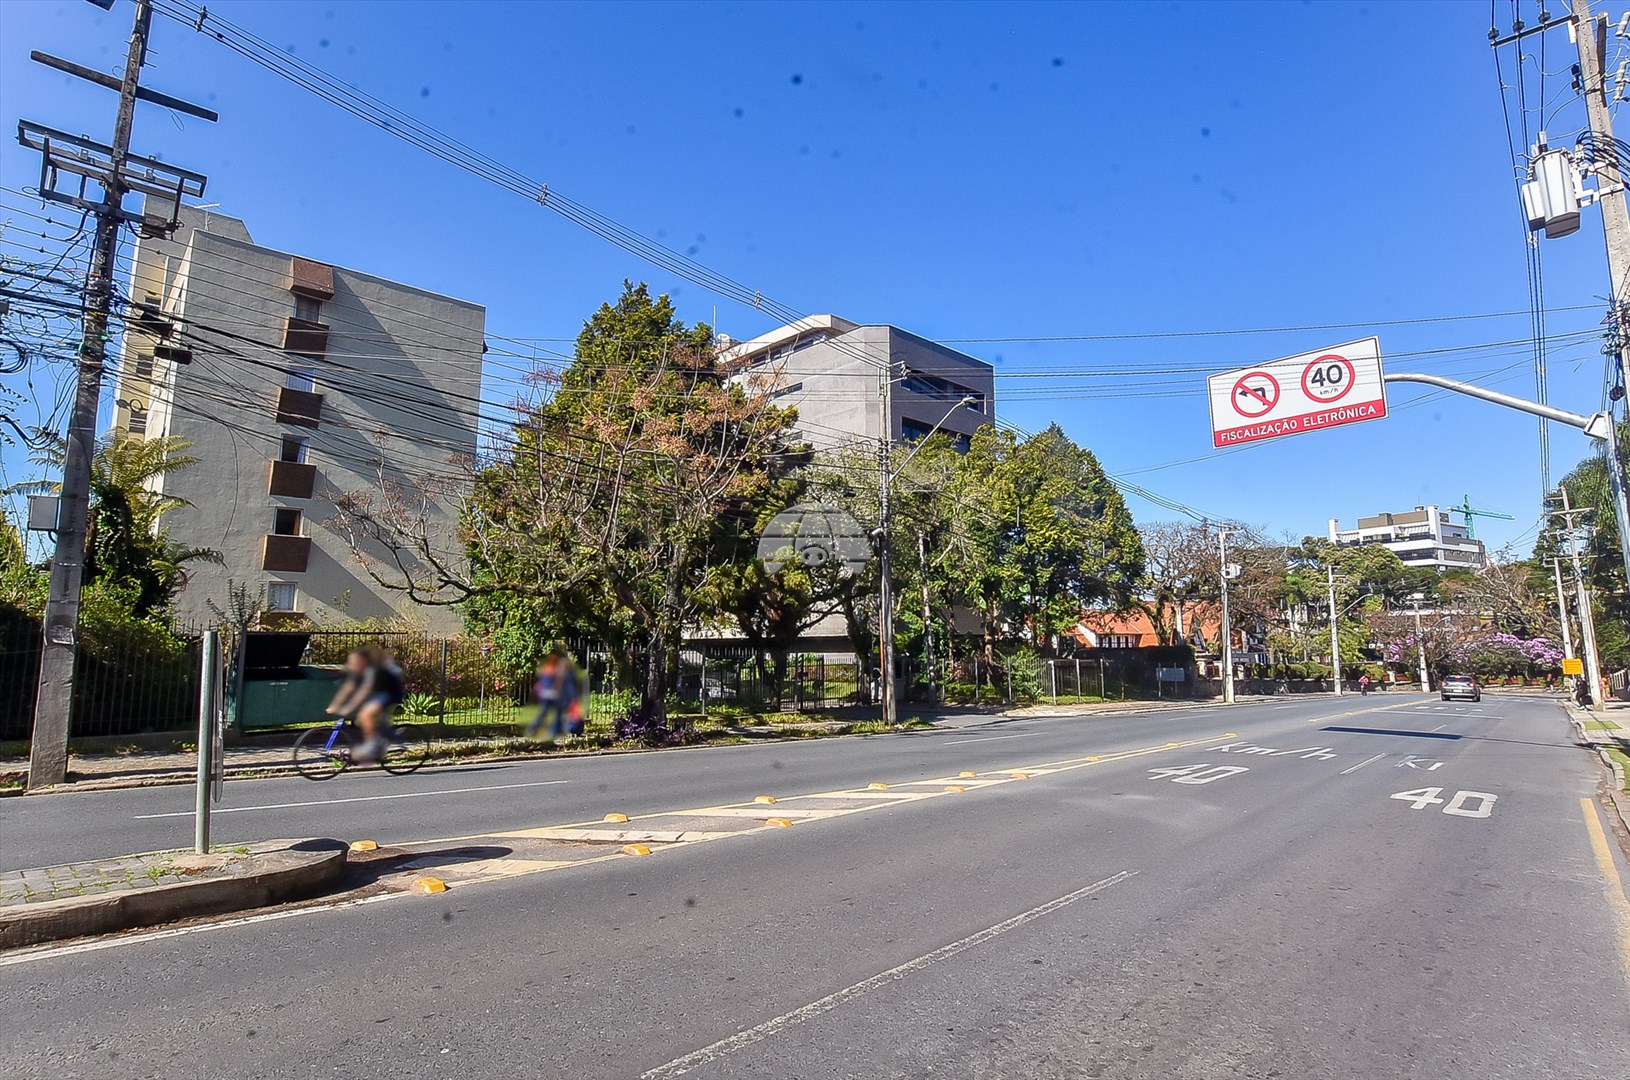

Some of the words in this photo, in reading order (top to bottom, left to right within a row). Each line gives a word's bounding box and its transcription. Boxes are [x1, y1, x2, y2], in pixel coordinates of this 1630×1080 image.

[1311, 364, 1343, 387] 40
[1221, 419, 1298, 442] FISCALIZAÇÃO
[1303, 404, 1377, 427] ELETRÔNICA
[1147, 763, 1250, 785] 40
[1390, 787, 1498, 818] 40
